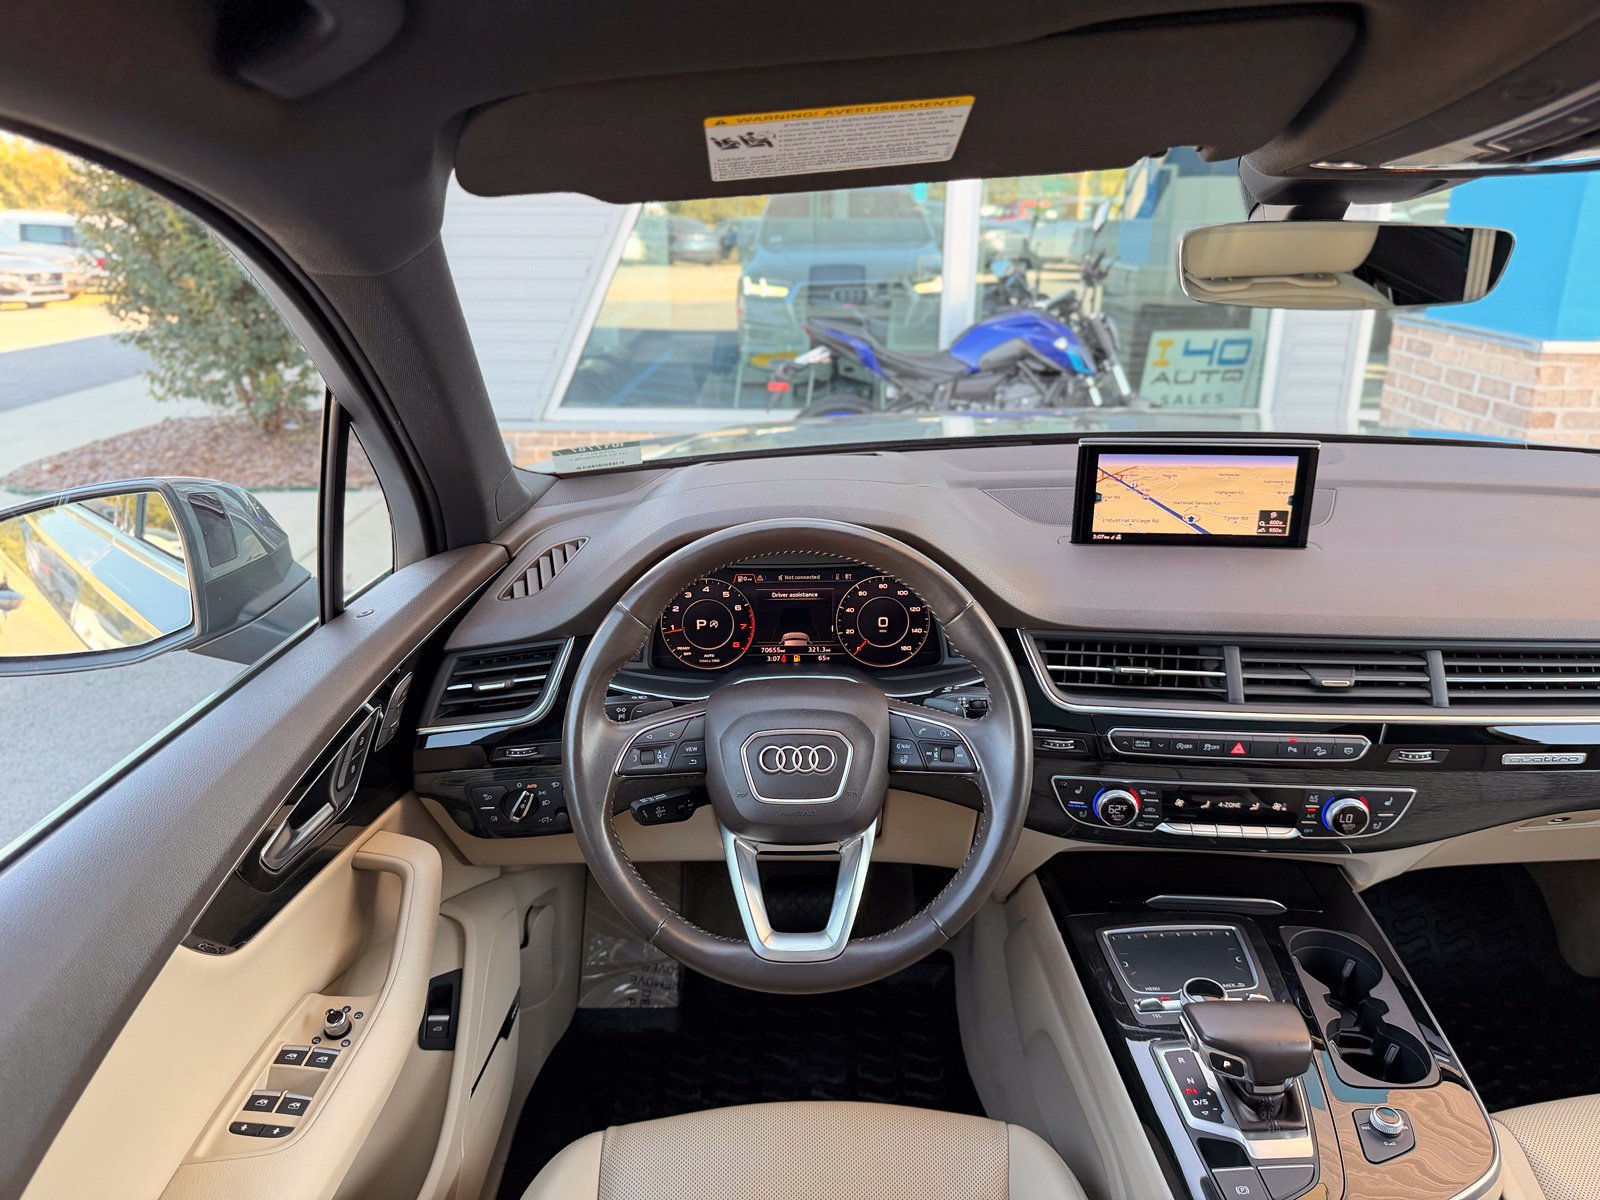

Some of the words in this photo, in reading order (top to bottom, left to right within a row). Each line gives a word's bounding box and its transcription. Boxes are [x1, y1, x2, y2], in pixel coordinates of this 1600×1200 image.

[736, 112, 818, 124] WARNING!
[824, 100, 960, 116] AVERTISSEMENT!
[1182, 338, 1253, 366] 40
[1150, 369, 1244, 385] AUTO
[1160, 393, 1224, 406] SALES
[696, 619, 707, 630] P
[877, 616, 889, 628] 0
[1509, 755, 1579, 763] quattro
[1218, 801, 1241, 809] 4-ZONE
[1339, 813, 1354, 823] LO
[1223, 1060, 1231, 1068] P
[1192, 1098, 1209, 1106] D/S
